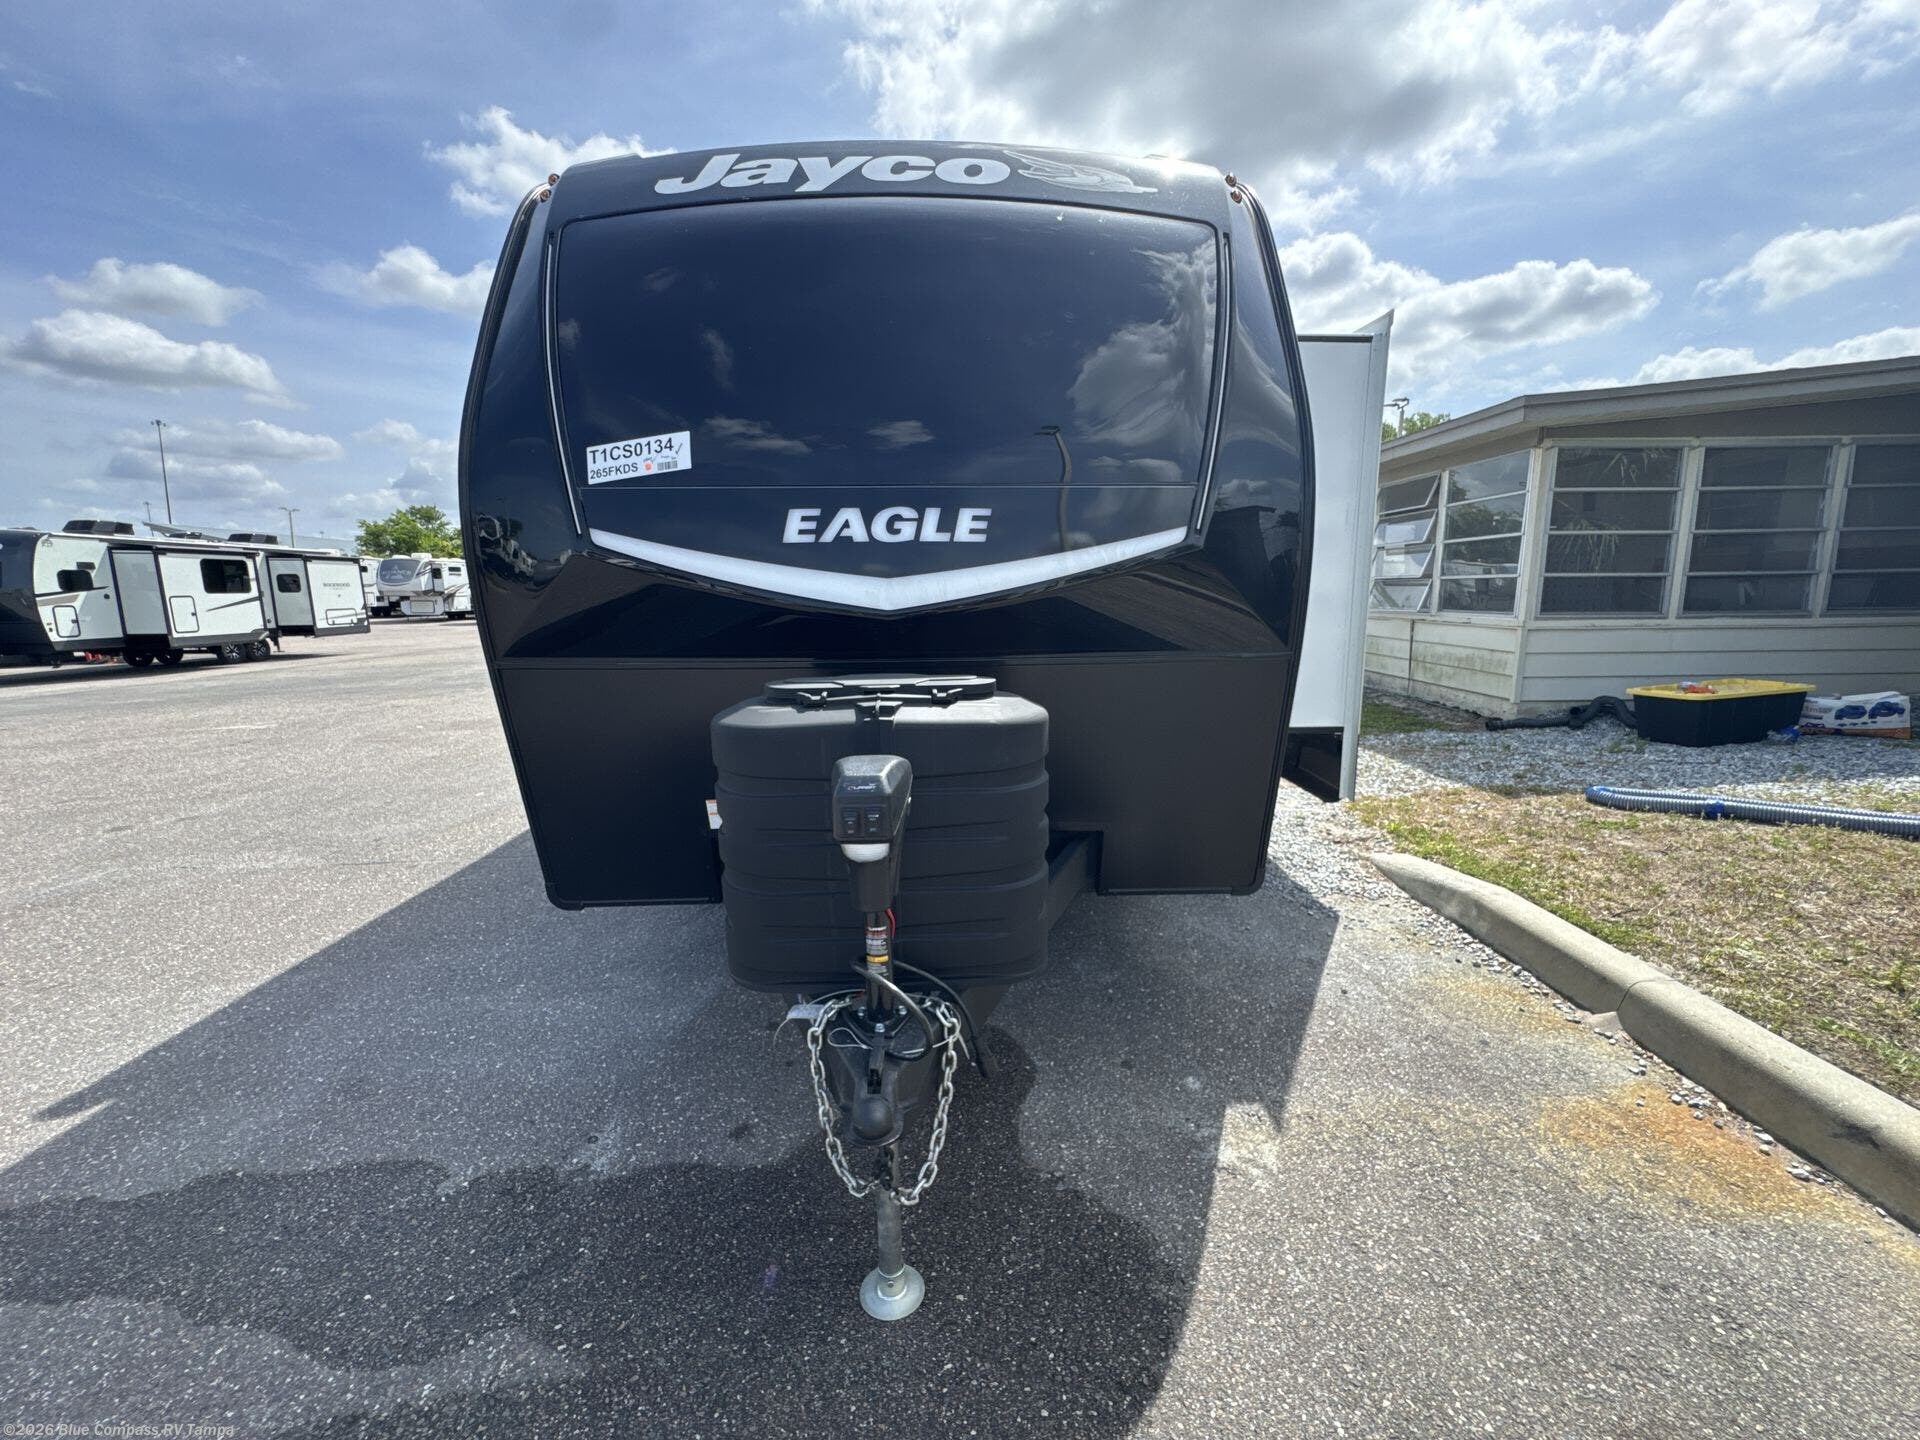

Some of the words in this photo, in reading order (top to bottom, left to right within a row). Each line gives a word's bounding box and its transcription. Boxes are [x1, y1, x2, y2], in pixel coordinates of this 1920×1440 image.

[654, 153, 1011, 194] Jayco
[589, 437, 674, 465] T1CS0134
[590, 462, 638, 480] 265FKDS
[782, 506, 993, 543] EAGLE
